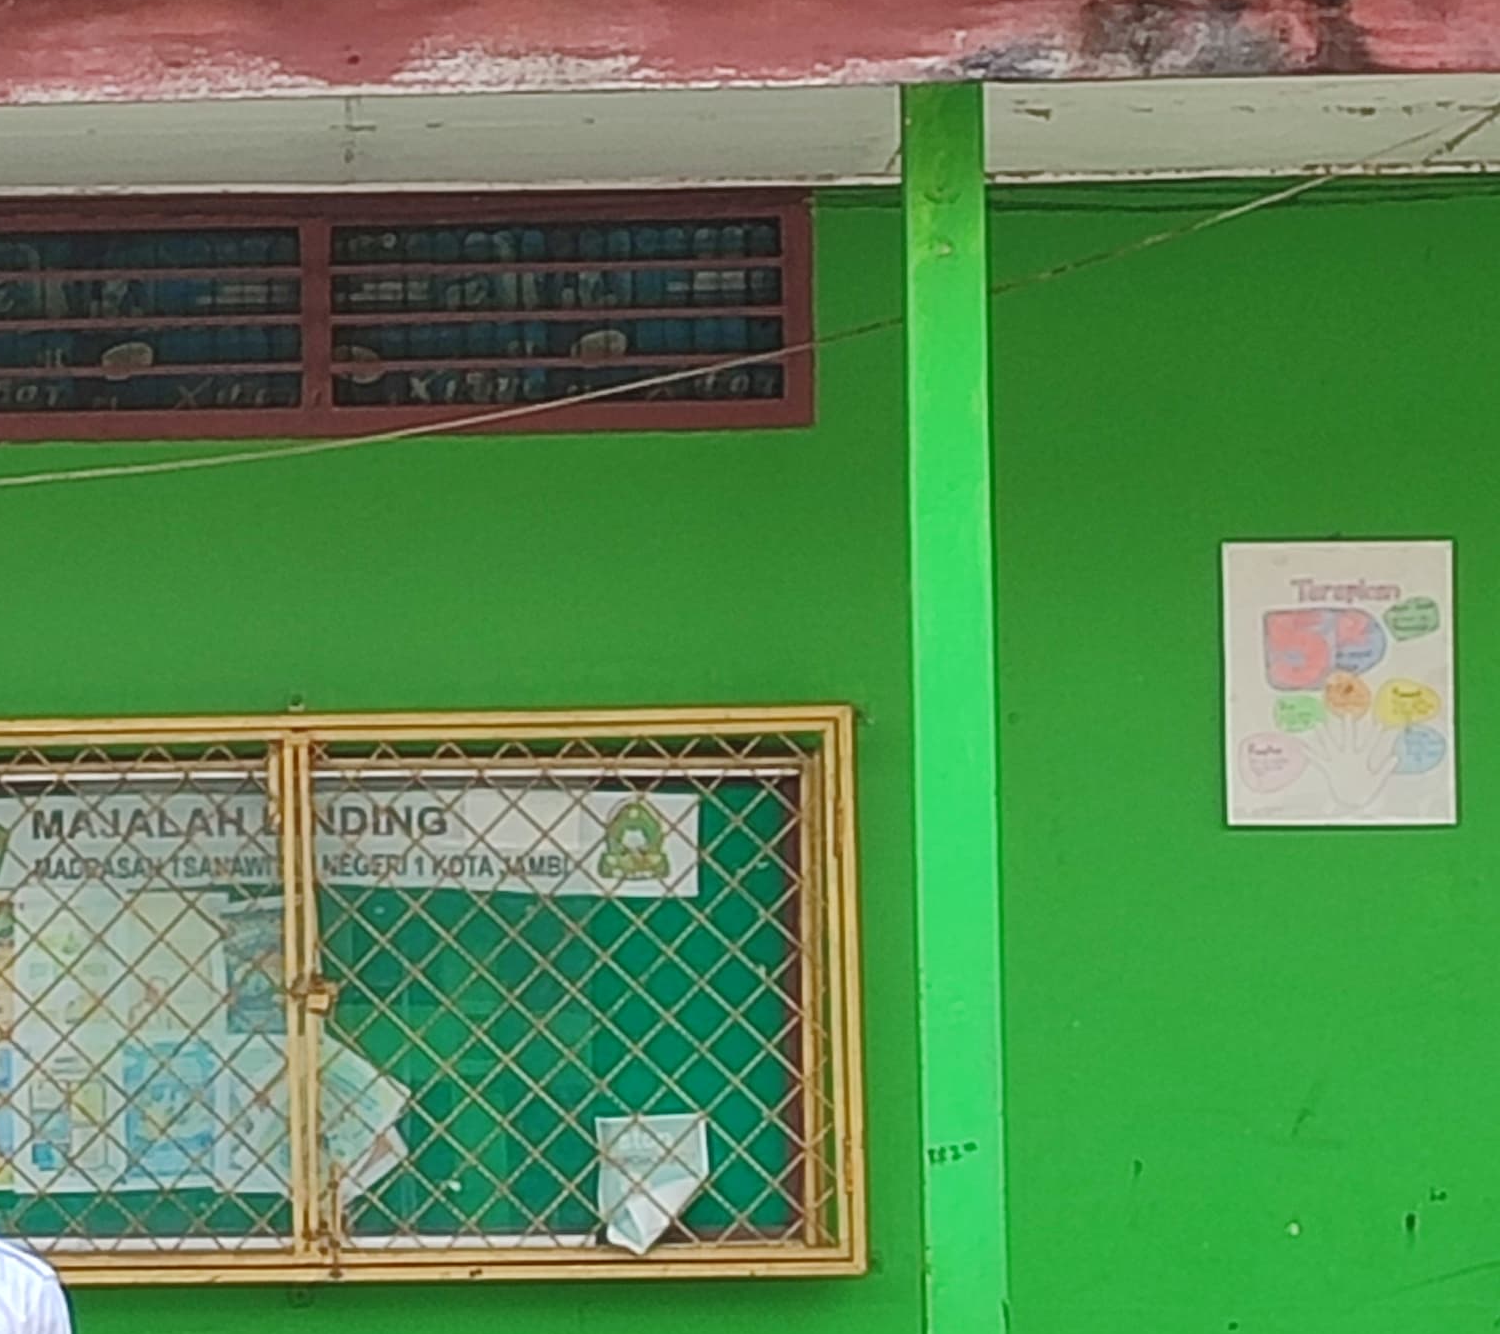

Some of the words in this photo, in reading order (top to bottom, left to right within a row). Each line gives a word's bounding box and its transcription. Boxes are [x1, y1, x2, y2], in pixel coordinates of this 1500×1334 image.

[32, 807, 245, 840] MAJALAH
[322, 854, 408, 877] NEGERI
[414, 855, 425, 877] 1
[433, 854, 495, 878] KOTA
